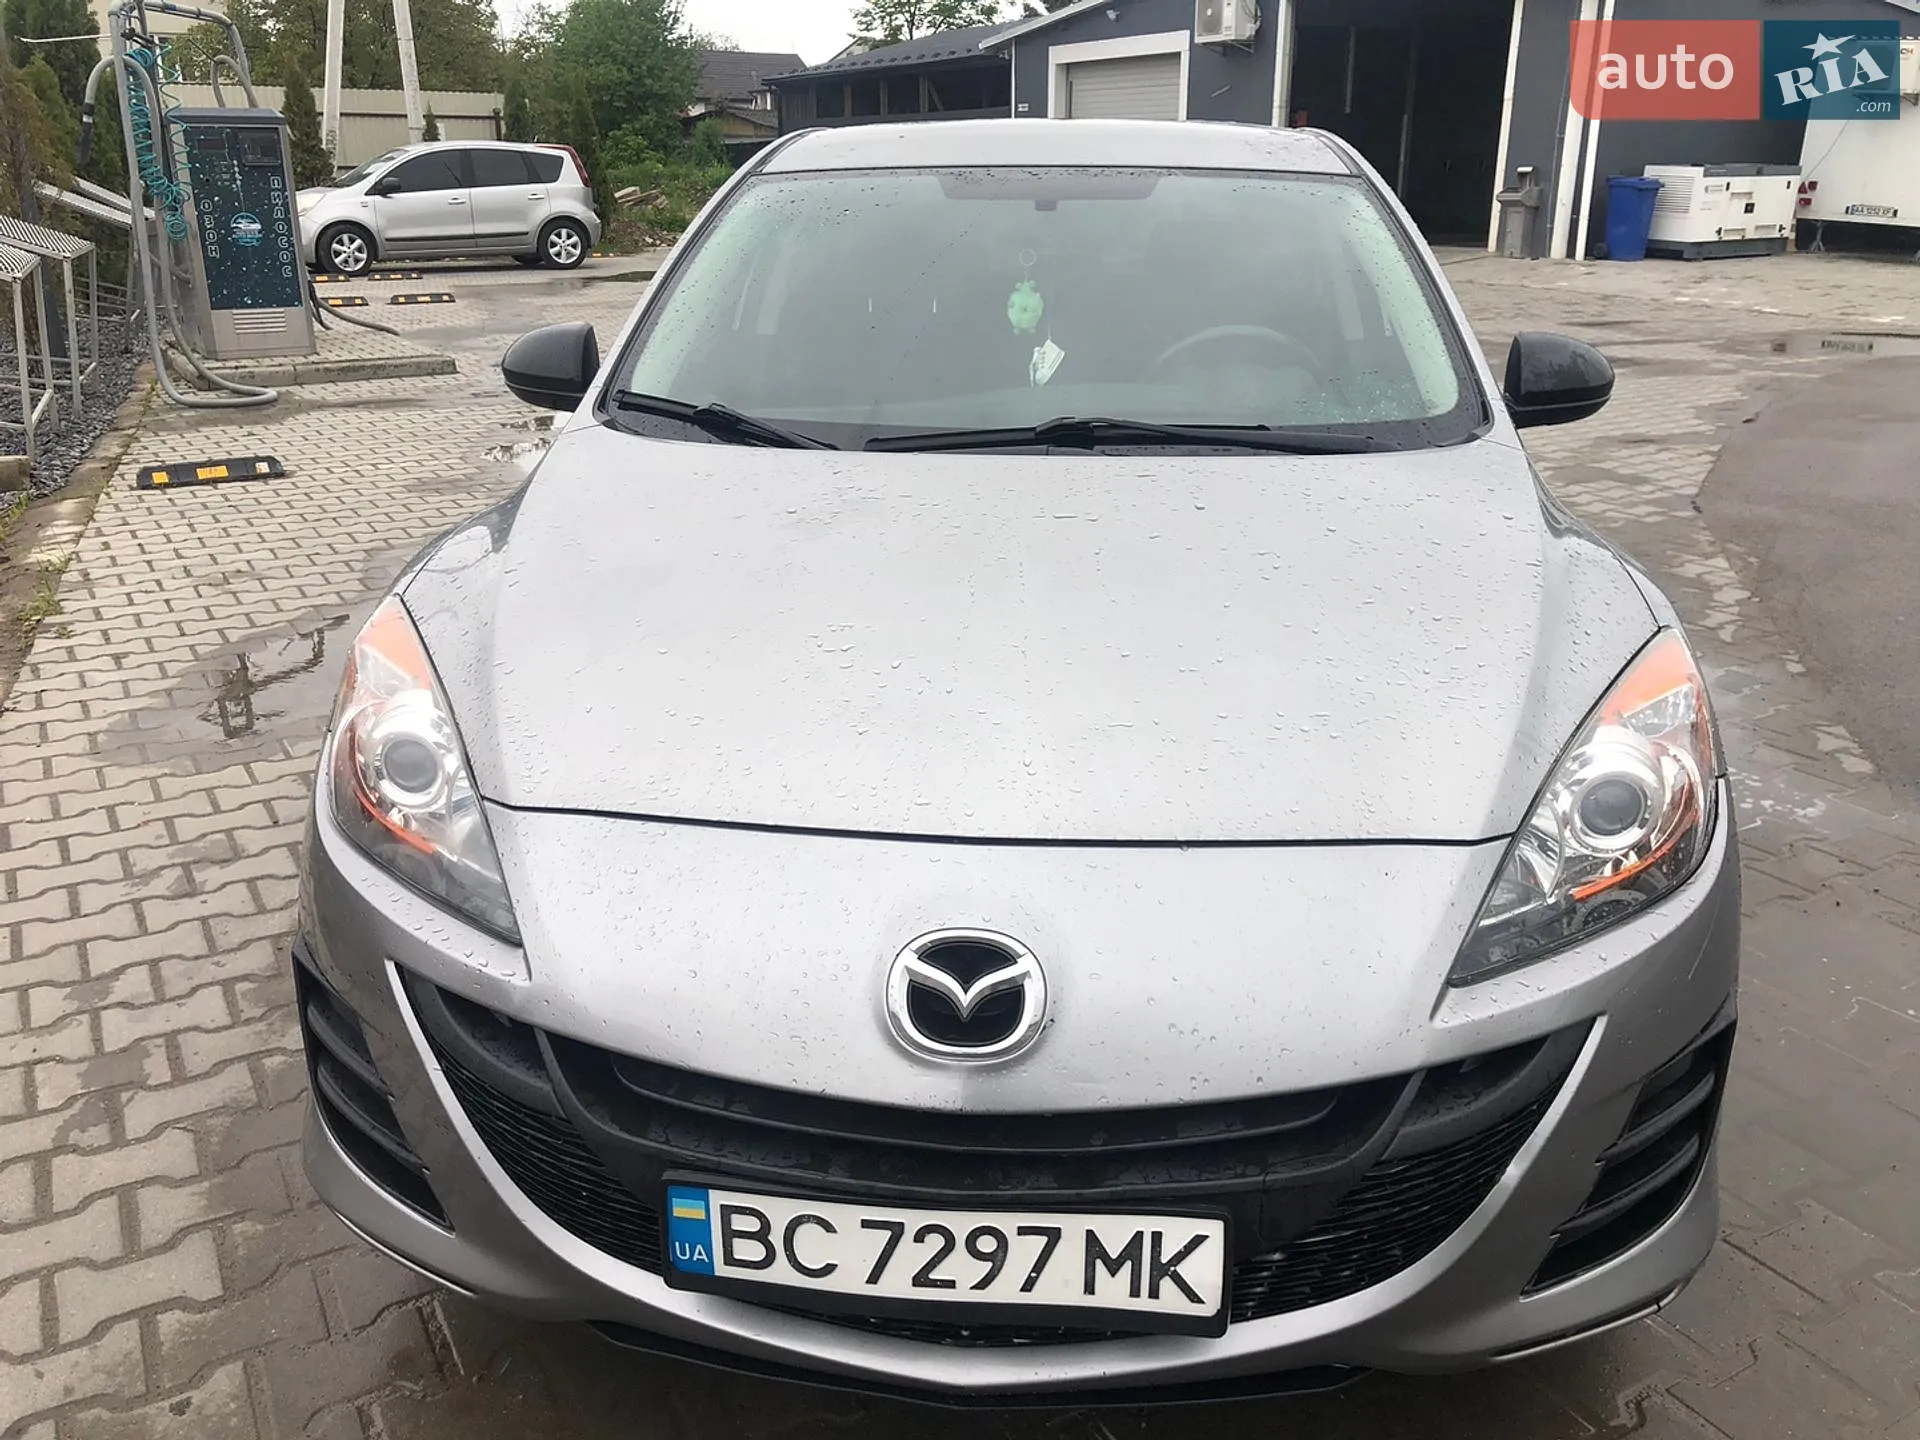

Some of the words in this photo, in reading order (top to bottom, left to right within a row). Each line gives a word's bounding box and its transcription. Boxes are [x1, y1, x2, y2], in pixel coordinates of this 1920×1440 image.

[675, 1240, 709, 1264] UA
[719, 1203, 838, 1279] BC
[860, 1218, 1062, 1293] 7297
[1083, 1228, 1210, 1305] MK
